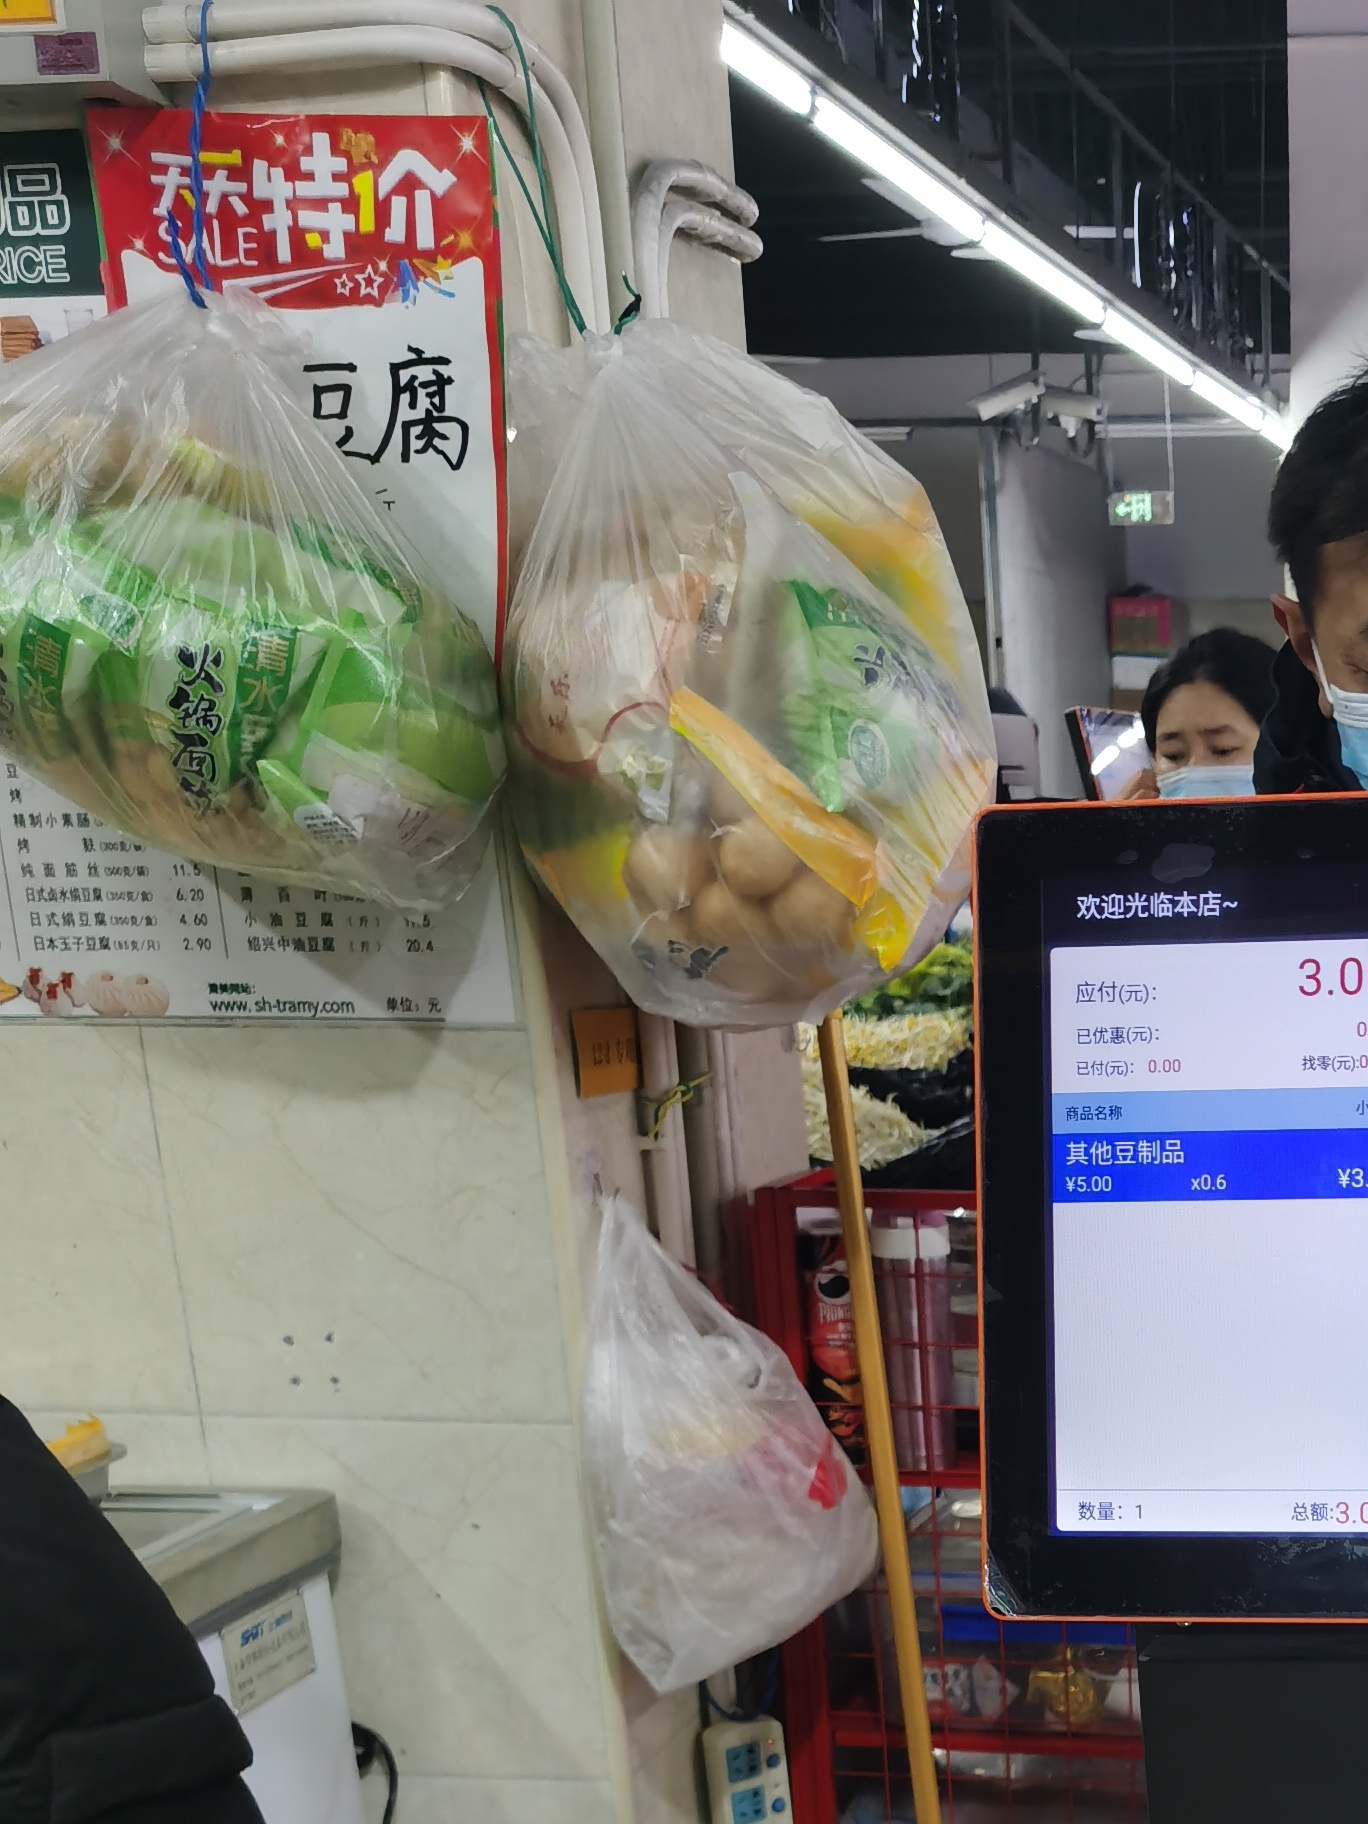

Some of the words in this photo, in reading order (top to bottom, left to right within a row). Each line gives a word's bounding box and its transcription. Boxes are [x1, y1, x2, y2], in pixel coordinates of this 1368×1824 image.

[4, 162, 70, 237] 品
[157, 219, 259, 267] SALE
[176, 887, 205, 902] 6.20
[1076, 891, 1239, 921] 欢迎光临本店~
[179, 912, 208, 927] 4.60
[182, 937, 212, 952] 2.90
[1147, 1058, 1182, 1075] 0.00
[1065, 1104, 1124, 1122] 商品名称
[1065, 1139, 1186, 1166] 其他豆制品
[1065, 1174, 1113, 1194] ¥5.00
[1190, 1173, 1228, 1192] x0.6
